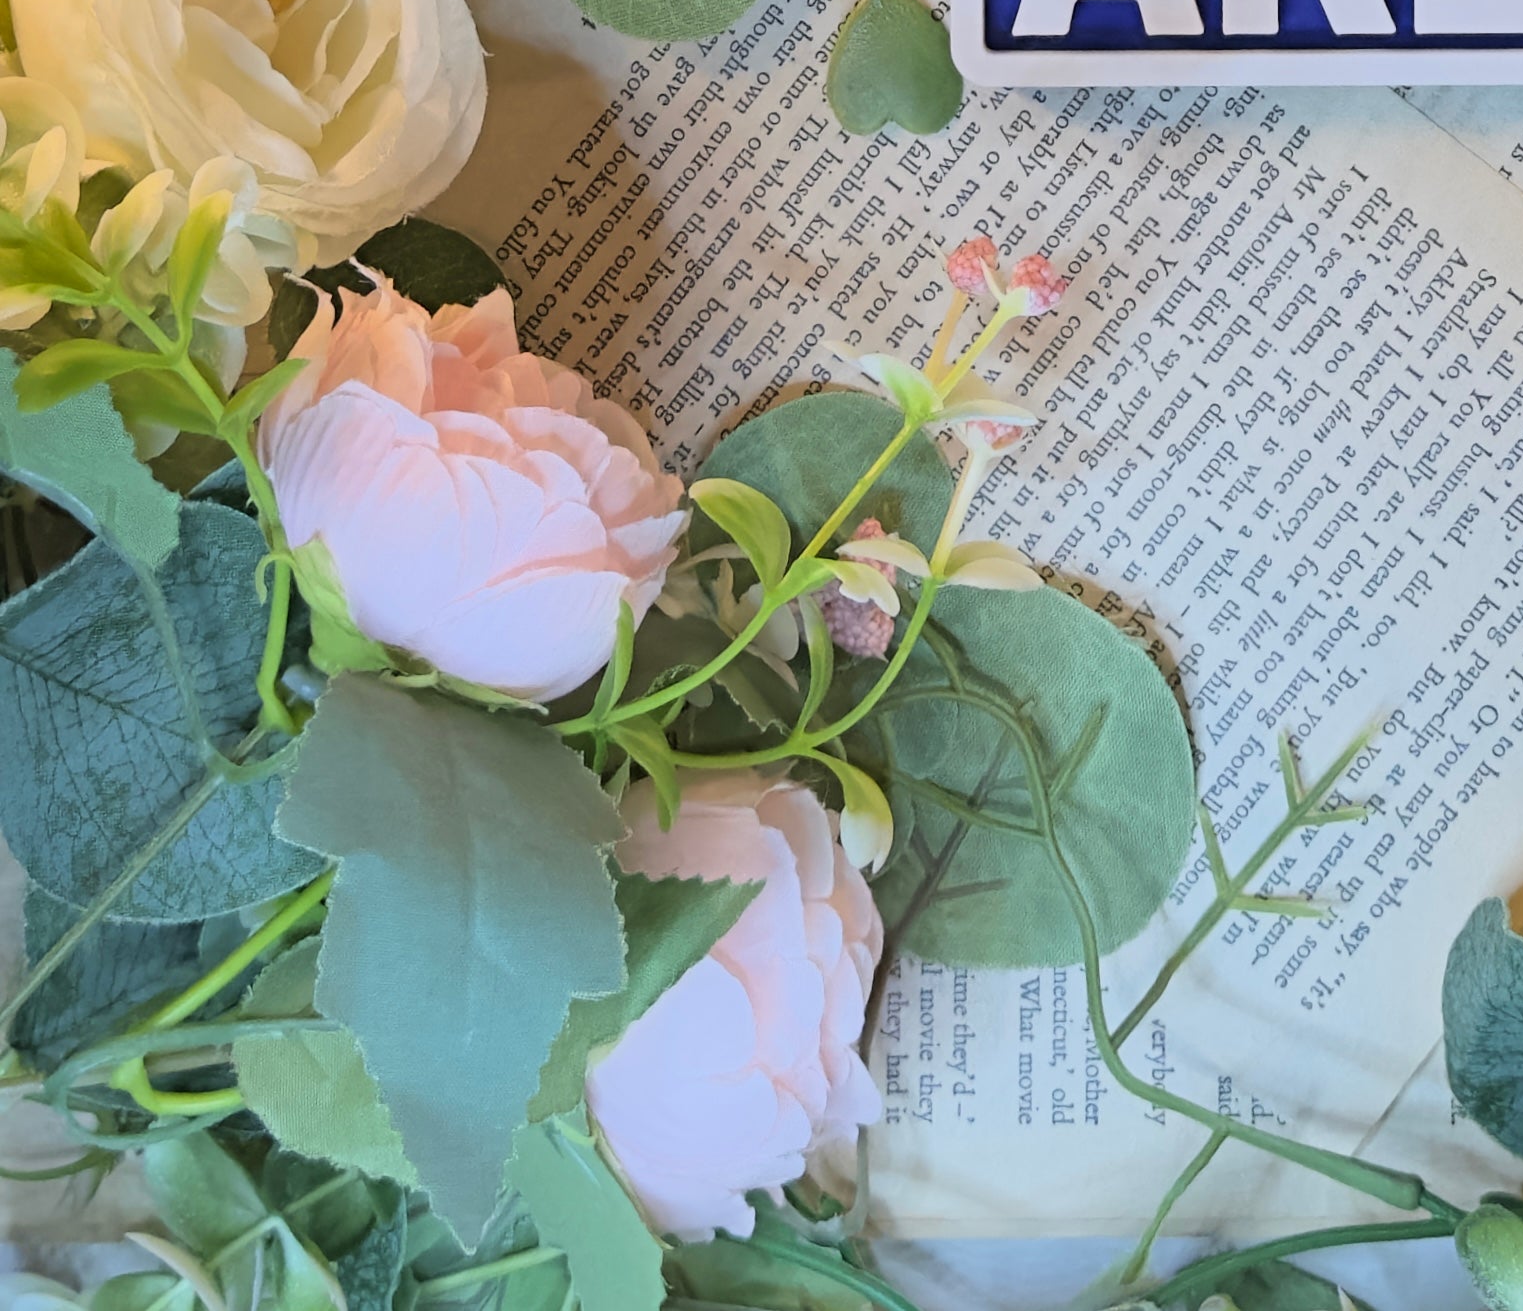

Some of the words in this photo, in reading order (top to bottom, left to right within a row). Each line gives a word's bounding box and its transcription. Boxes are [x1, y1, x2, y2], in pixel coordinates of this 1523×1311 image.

[827, 126, 899, 208] horrible
[1293, 164, 1327, 201] Mr
[784, 212, 835, 264] kind.
[1226, 202, 1294, 287] Antolini
[748, 271, 790, 310] The
[709, 314, 748, 359] man
[1150, 348, 1181, 383] say
[654, 363, 715, 427] falling
[1078, 385, 1152, 471] anything
[1491, 736, 1514, 758] to
[1456, 760, 1500, 804] hate
[1405, 800, 1459, 871] people
[1369, 876, 1409, 919] who
[1334, 921, 1371, 957] say,
[1019, 975, 1043, 1043] What
[1017, 1052, 1039, 1125] movie
[1051, 1088, 1075, 1126] old
